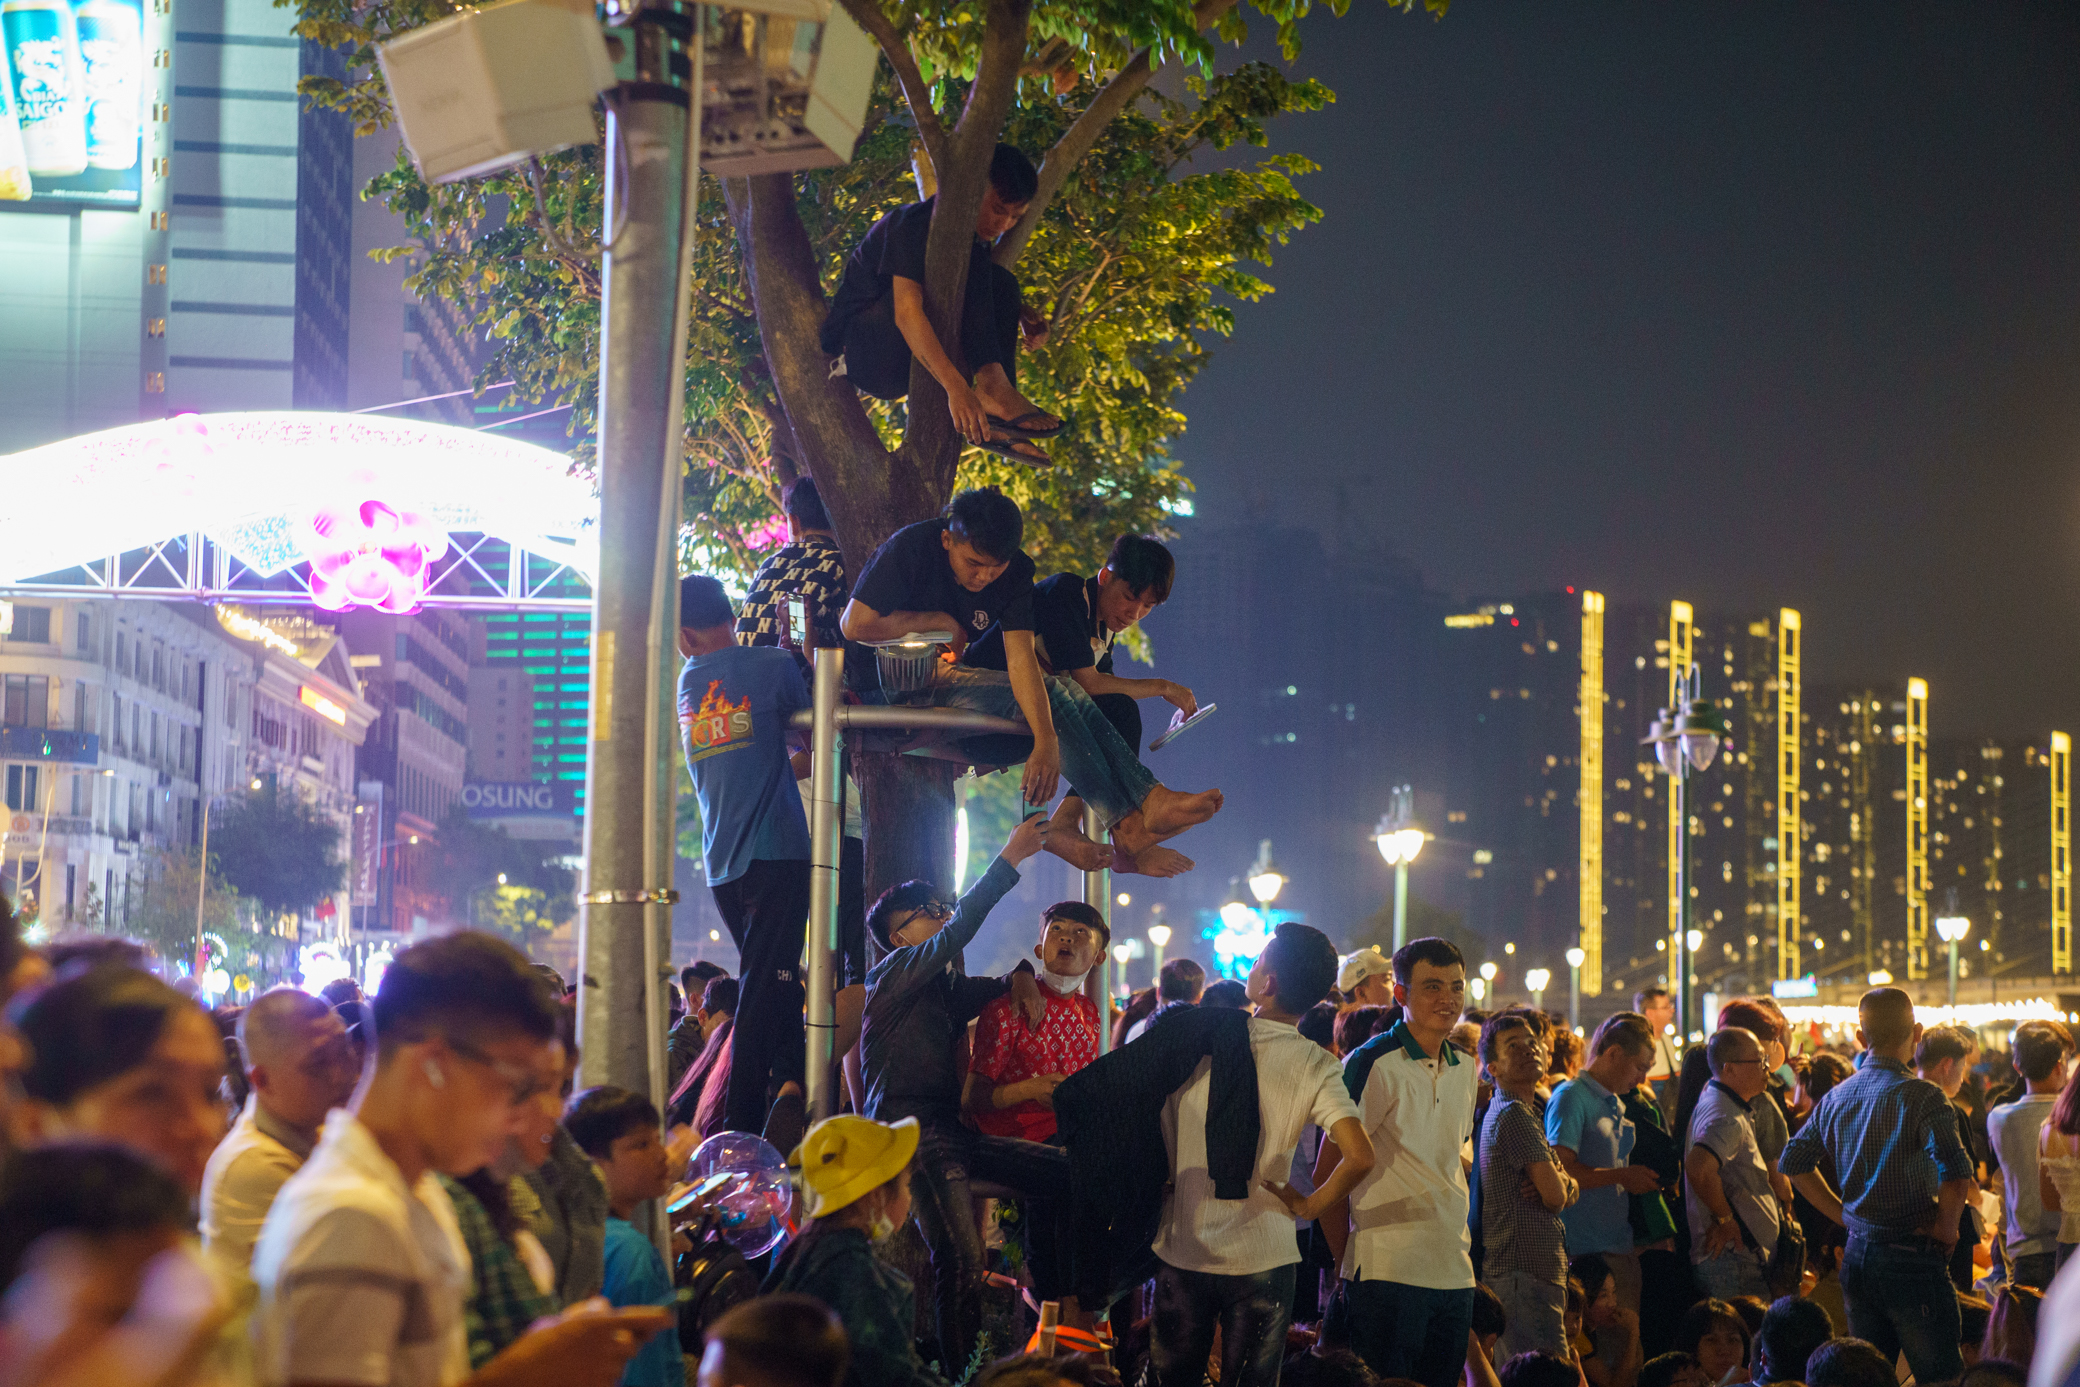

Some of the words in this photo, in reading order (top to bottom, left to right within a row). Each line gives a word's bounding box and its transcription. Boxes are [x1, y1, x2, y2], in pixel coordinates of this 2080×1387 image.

[769, 557, 801, 570] NY
[782, 567, 816, 580] NY
[755, 579, 784, 592] NY
[741, 602, 769, 618] NY
